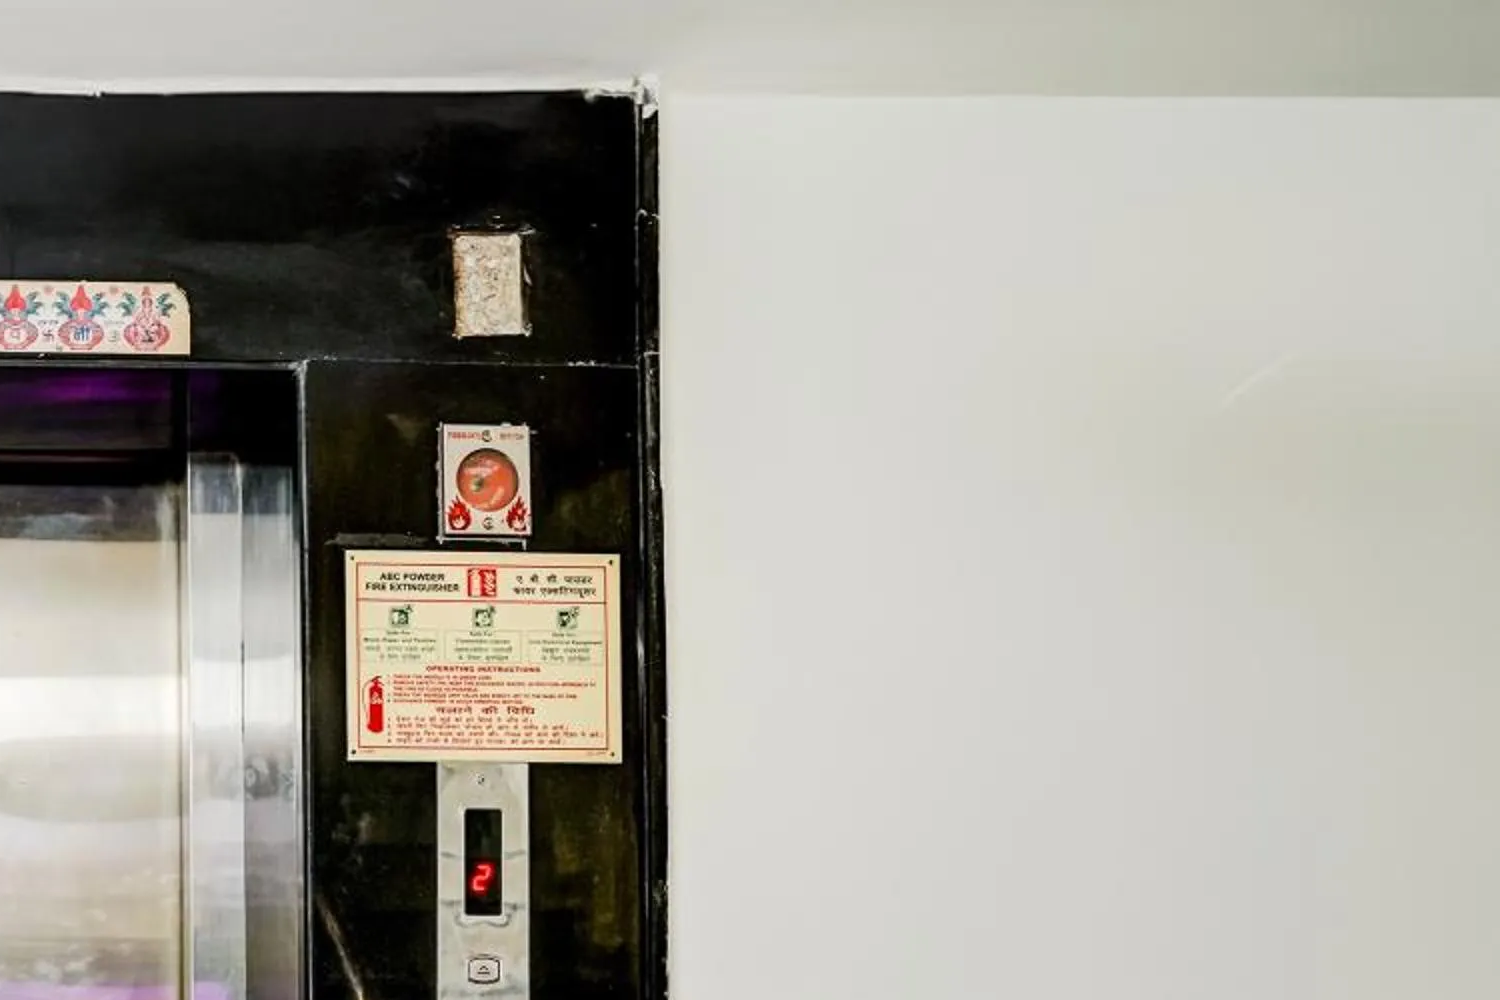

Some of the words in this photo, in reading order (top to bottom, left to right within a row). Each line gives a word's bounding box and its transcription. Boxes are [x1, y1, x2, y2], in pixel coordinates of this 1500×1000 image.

[380, 571, 401, 581] ABC
[403, 573, 446, 582] POWDER
[365, 582, 387, 591] FIRE
[389, 583, 460, 593] EXTINGUISHER
[426, 665, 475, 673] OPERATING
[478, 666, 542, 674] INSTRUCTIONS
[472, 864, 494, 892] 2
